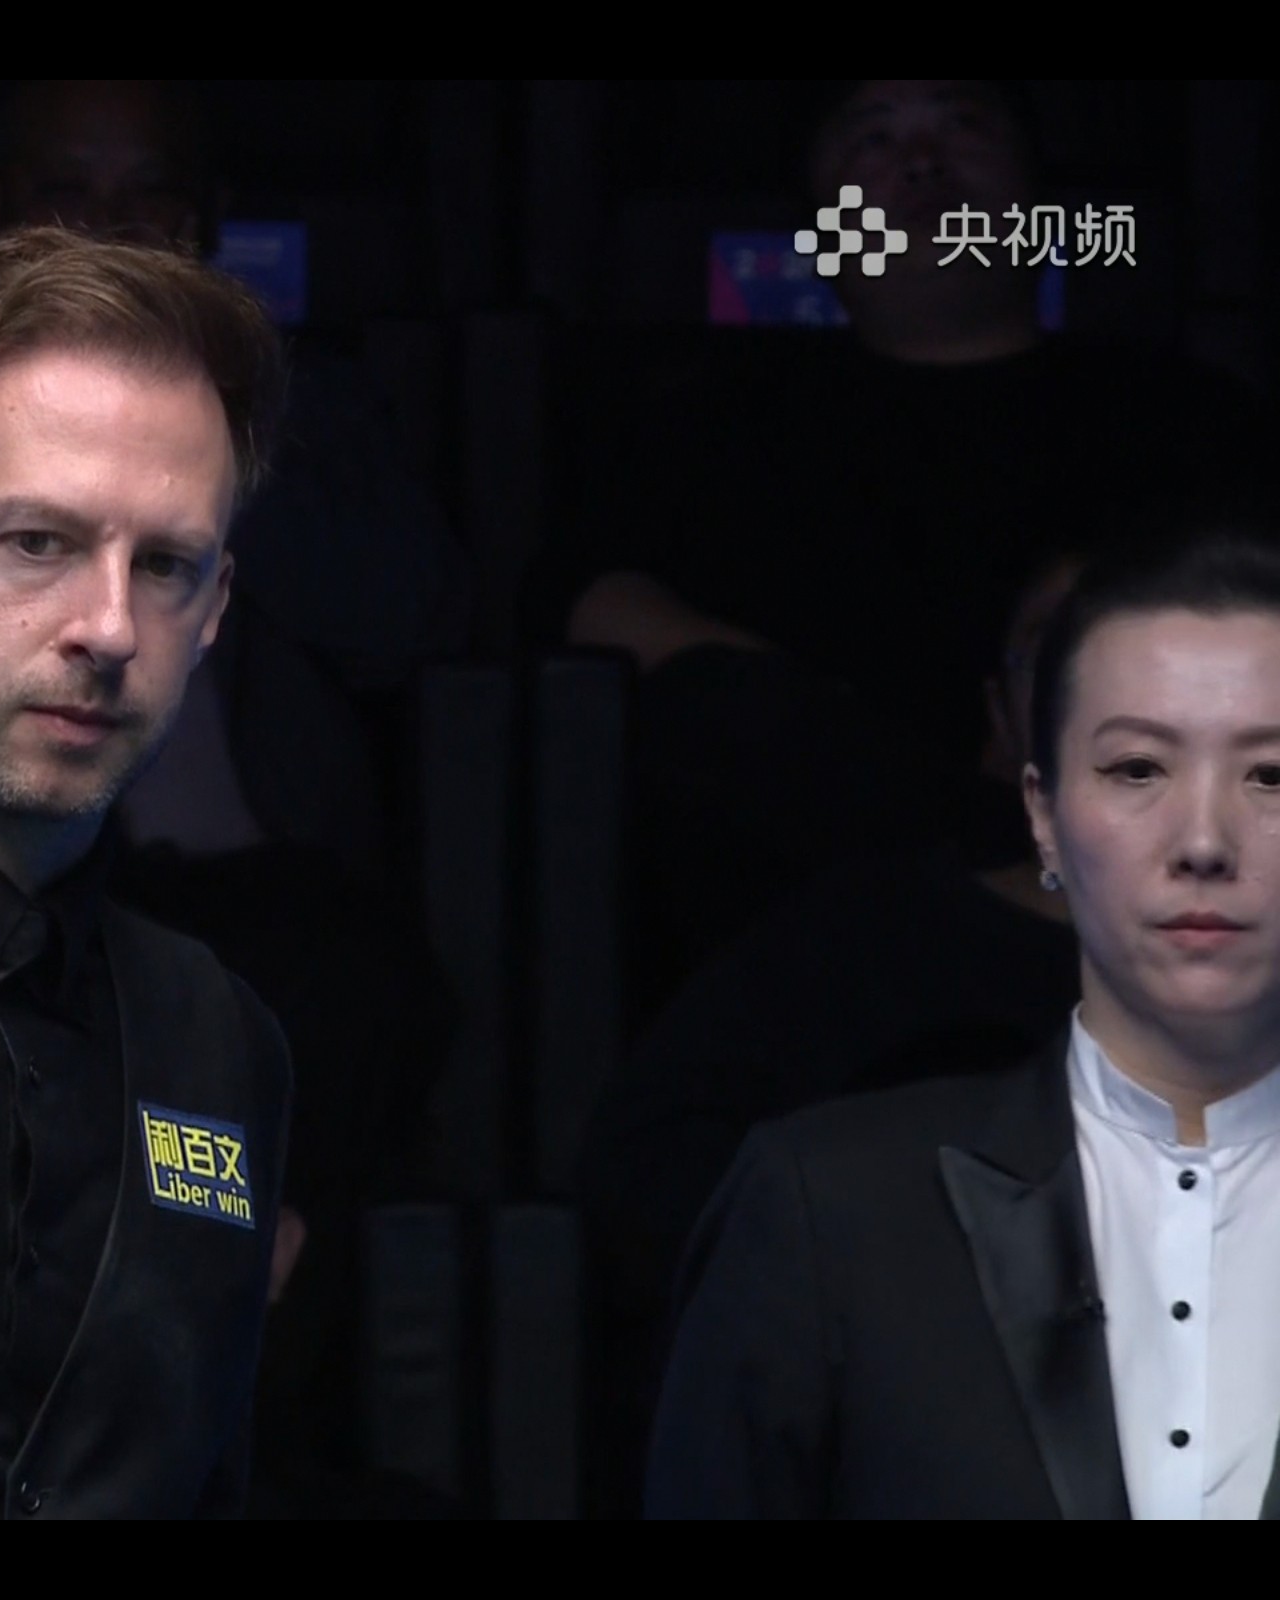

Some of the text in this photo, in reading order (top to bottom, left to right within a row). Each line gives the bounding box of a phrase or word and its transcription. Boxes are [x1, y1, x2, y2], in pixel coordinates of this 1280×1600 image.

[149, 1118, 246, 1187] 利百文
[216, 1187, 251, 1220] win
